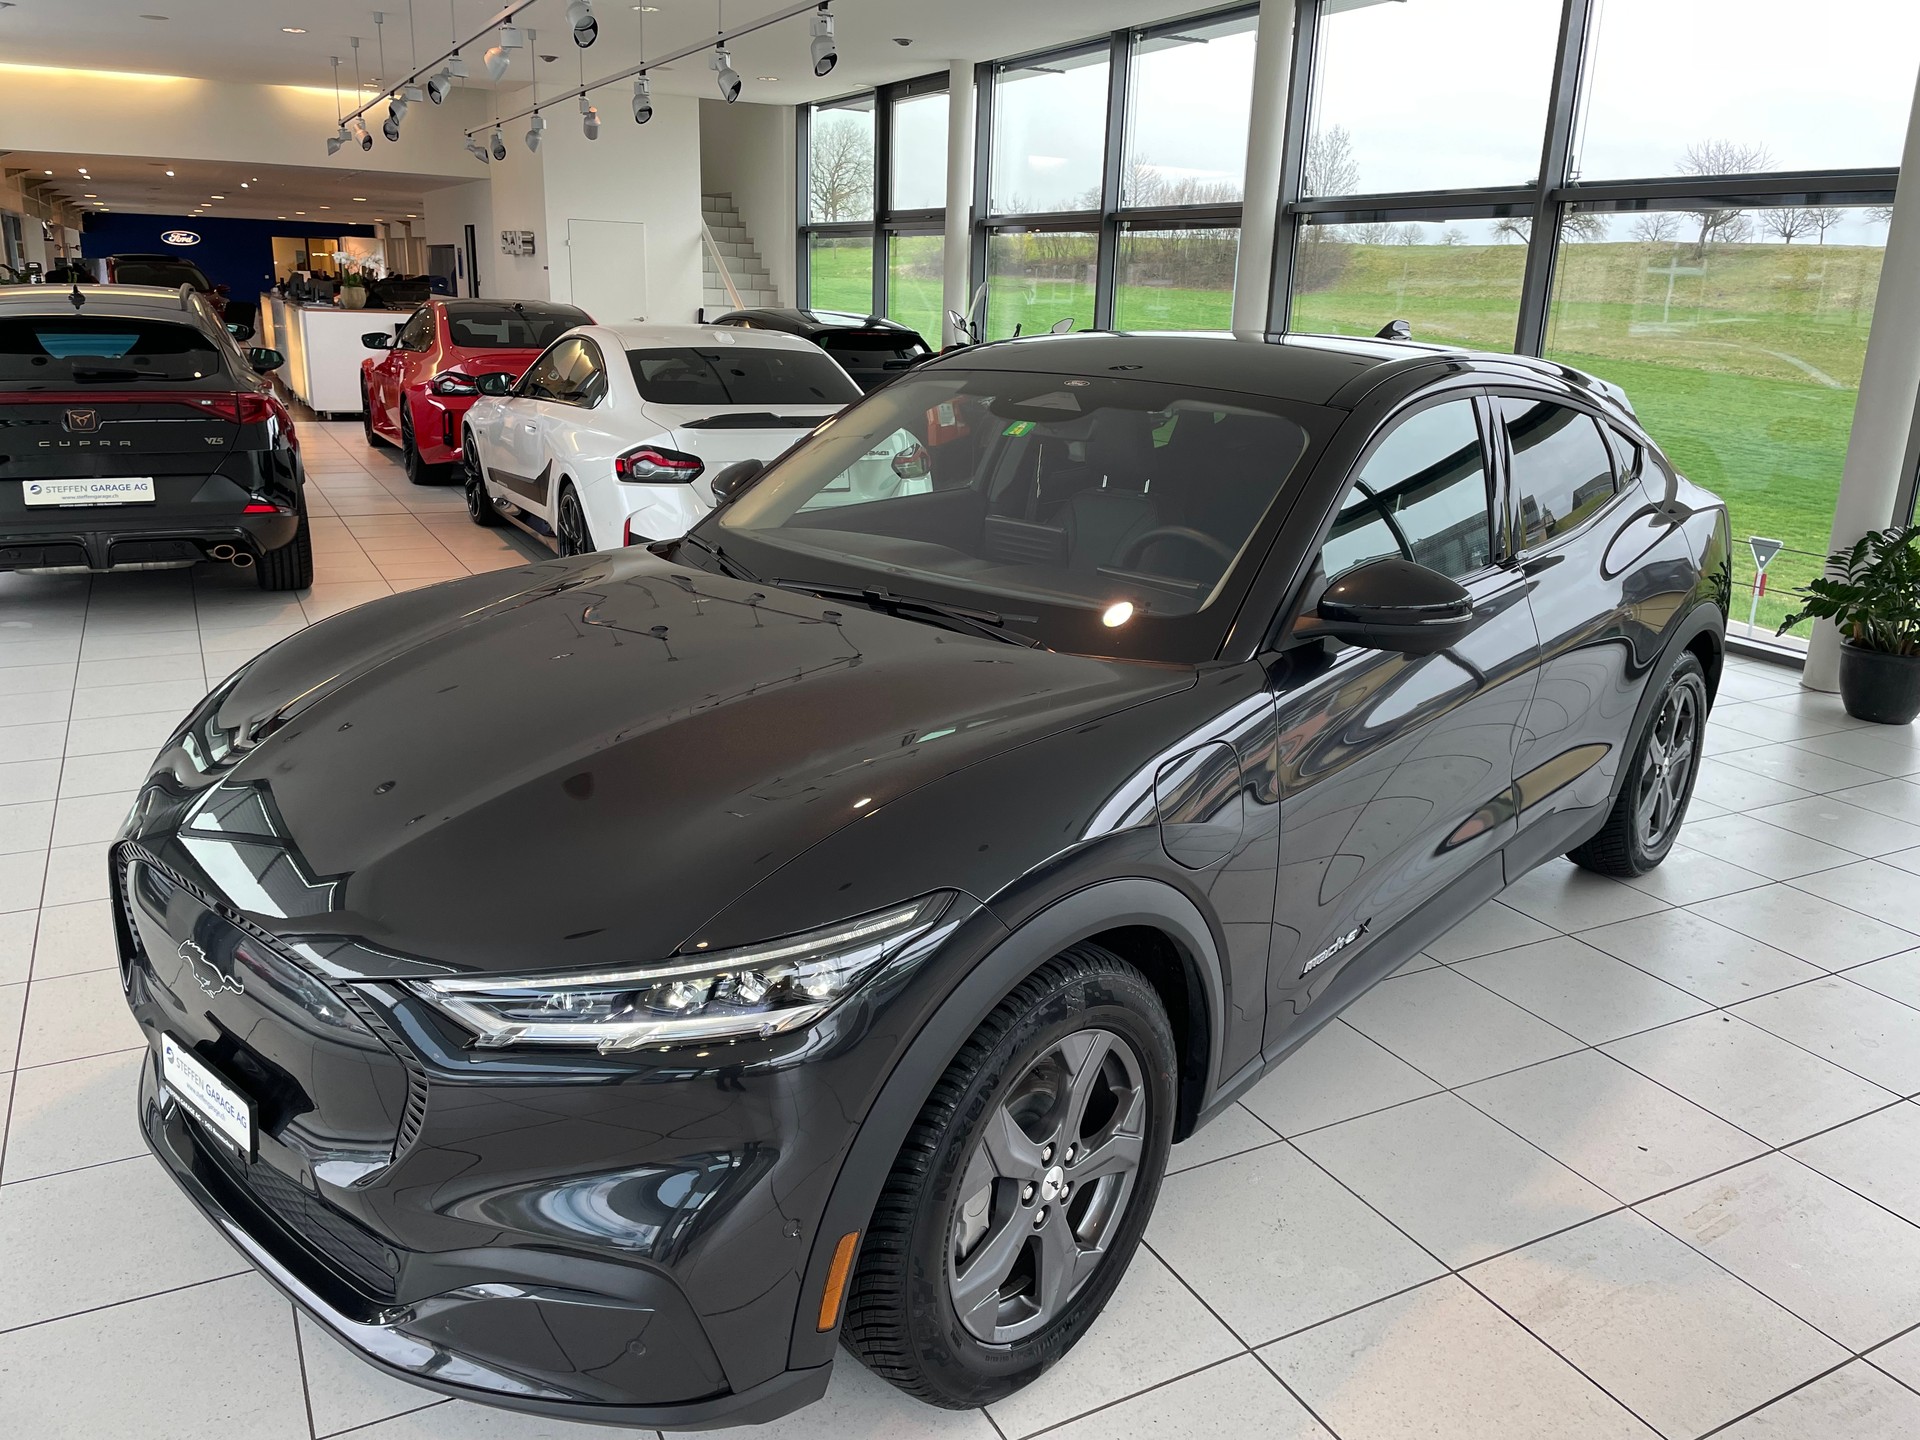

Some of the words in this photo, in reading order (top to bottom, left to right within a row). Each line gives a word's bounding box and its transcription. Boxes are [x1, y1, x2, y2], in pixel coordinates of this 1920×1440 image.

[204, 437, 224, 445] VZ5
[45, 485, 88, 494] STEFFEN
[90, 483, 131, 492] GARAGE
[134, 483, 148, 491] AG
[176, 1057, 205, 1090] STEFFEN
[205, 1083, 235, 1118] GARAGE
[236, 1113, 247, 1129] AG
